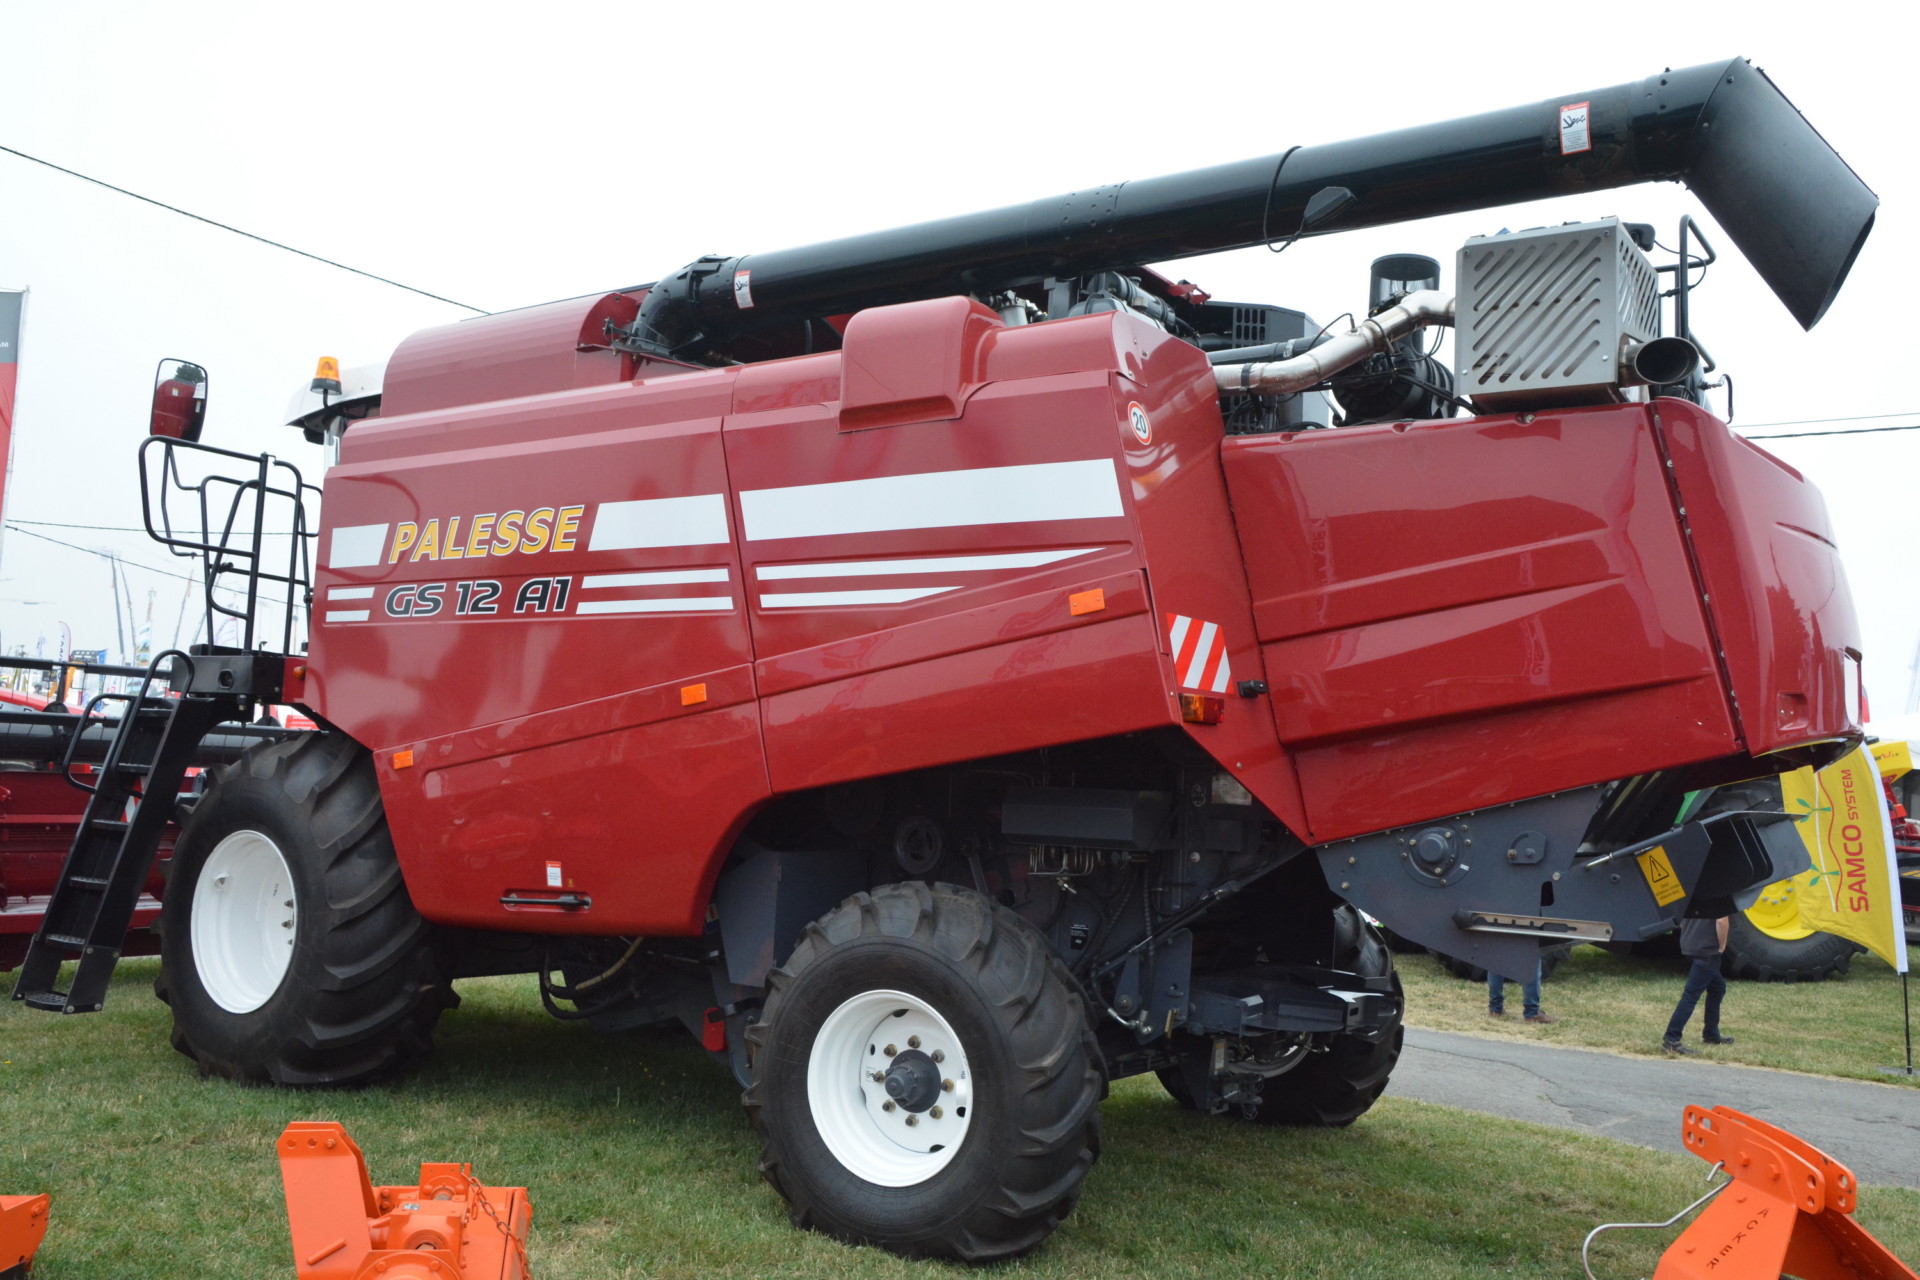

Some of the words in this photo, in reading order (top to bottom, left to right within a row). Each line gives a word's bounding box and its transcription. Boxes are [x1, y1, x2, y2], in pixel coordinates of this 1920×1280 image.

[1132, 411, 1147, 434] 20
[388, 505, 585, 564] PALESSE
[385, 583, 447, 617] GS
[455, 580, 502, 615] 12
[513, 576, 573, 614] A1
[1842, 769, 1859, 820] SYSTEM
[1842, 824, 1869, 912] SAMCO
[1706, 1207, 1770, 1270] ACKER
